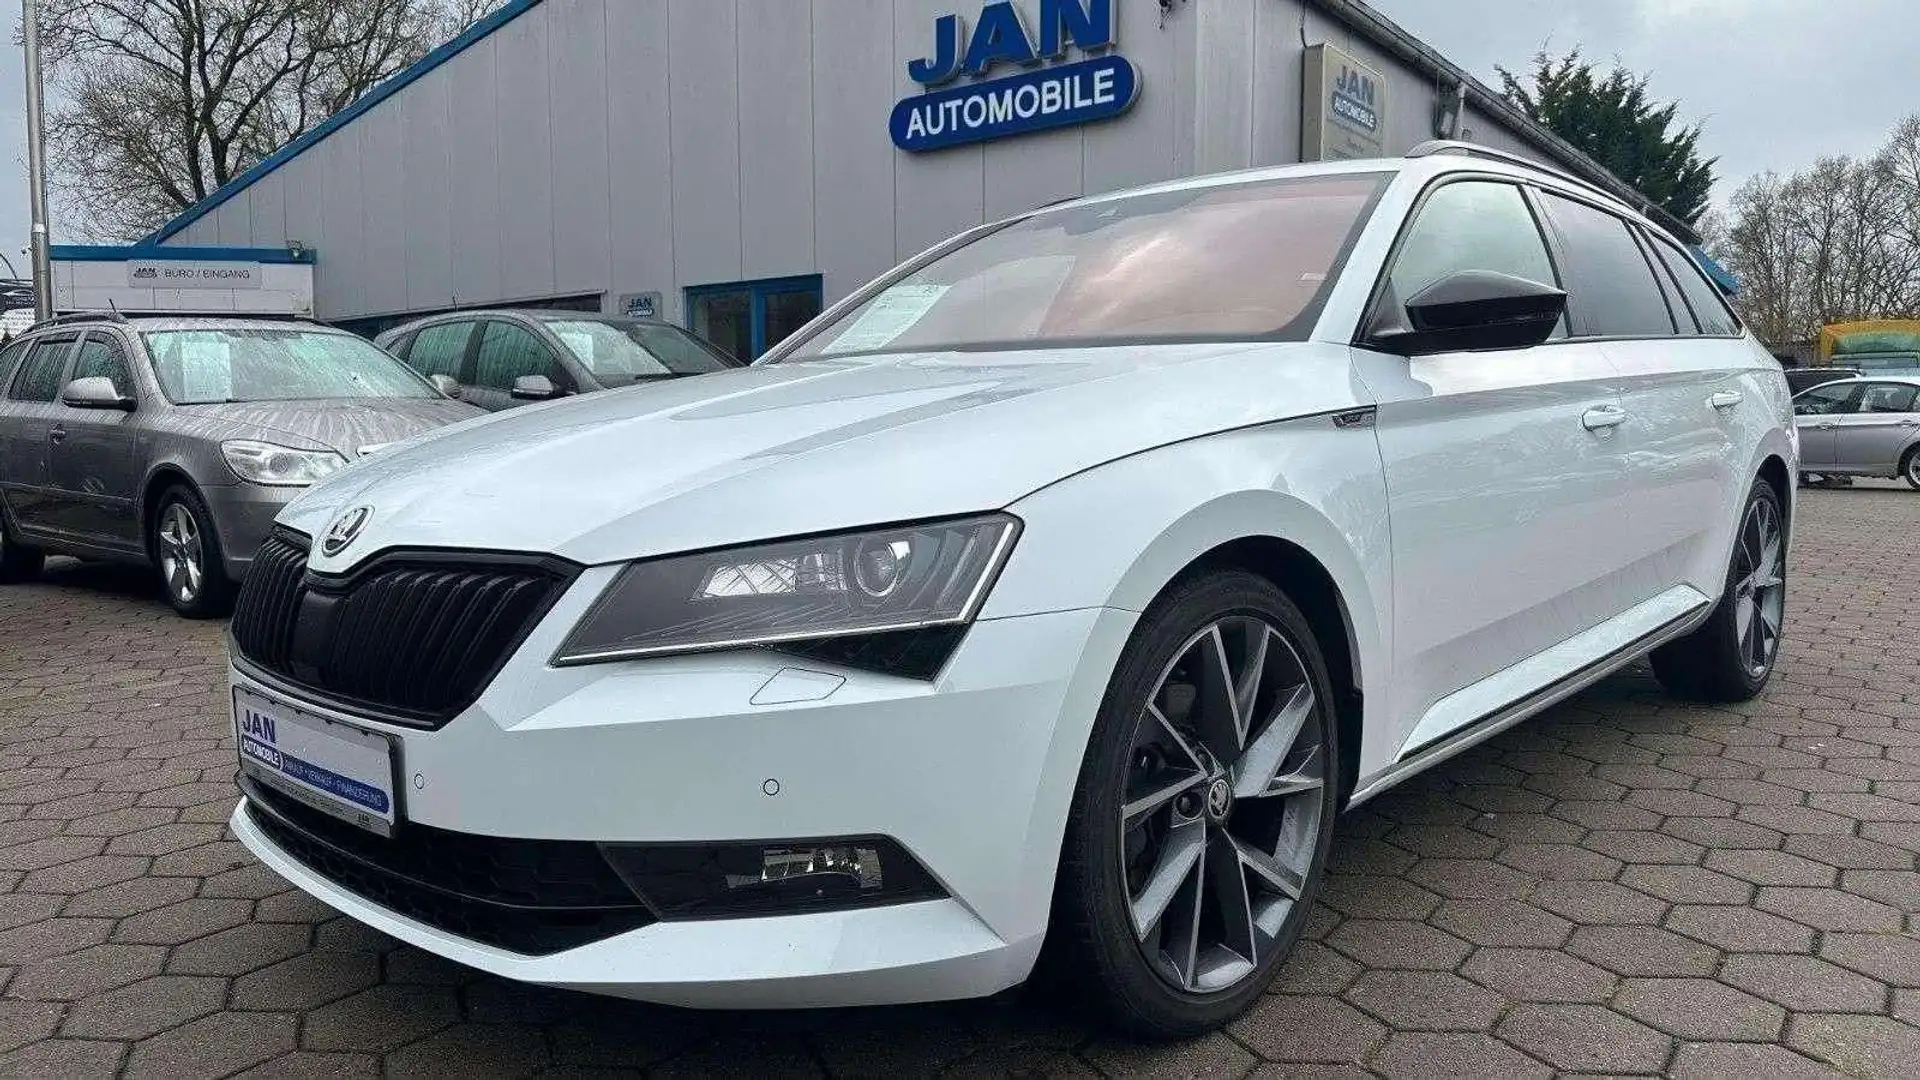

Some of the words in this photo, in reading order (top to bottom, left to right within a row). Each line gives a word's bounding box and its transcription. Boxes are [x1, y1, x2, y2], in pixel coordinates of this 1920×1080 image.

[908, 0, 1112, 83] JAN
[1336, 65, 1374, 106] JAN
[906, 68, 1115, 139] AUTOMOBILE
[203, 268, 250, 279] EINGANG
[628, 297, 653, 309] JAN
[243, 709, 276, 743] JAN
[243, 739, 281, 767] AUTOMOBILE
